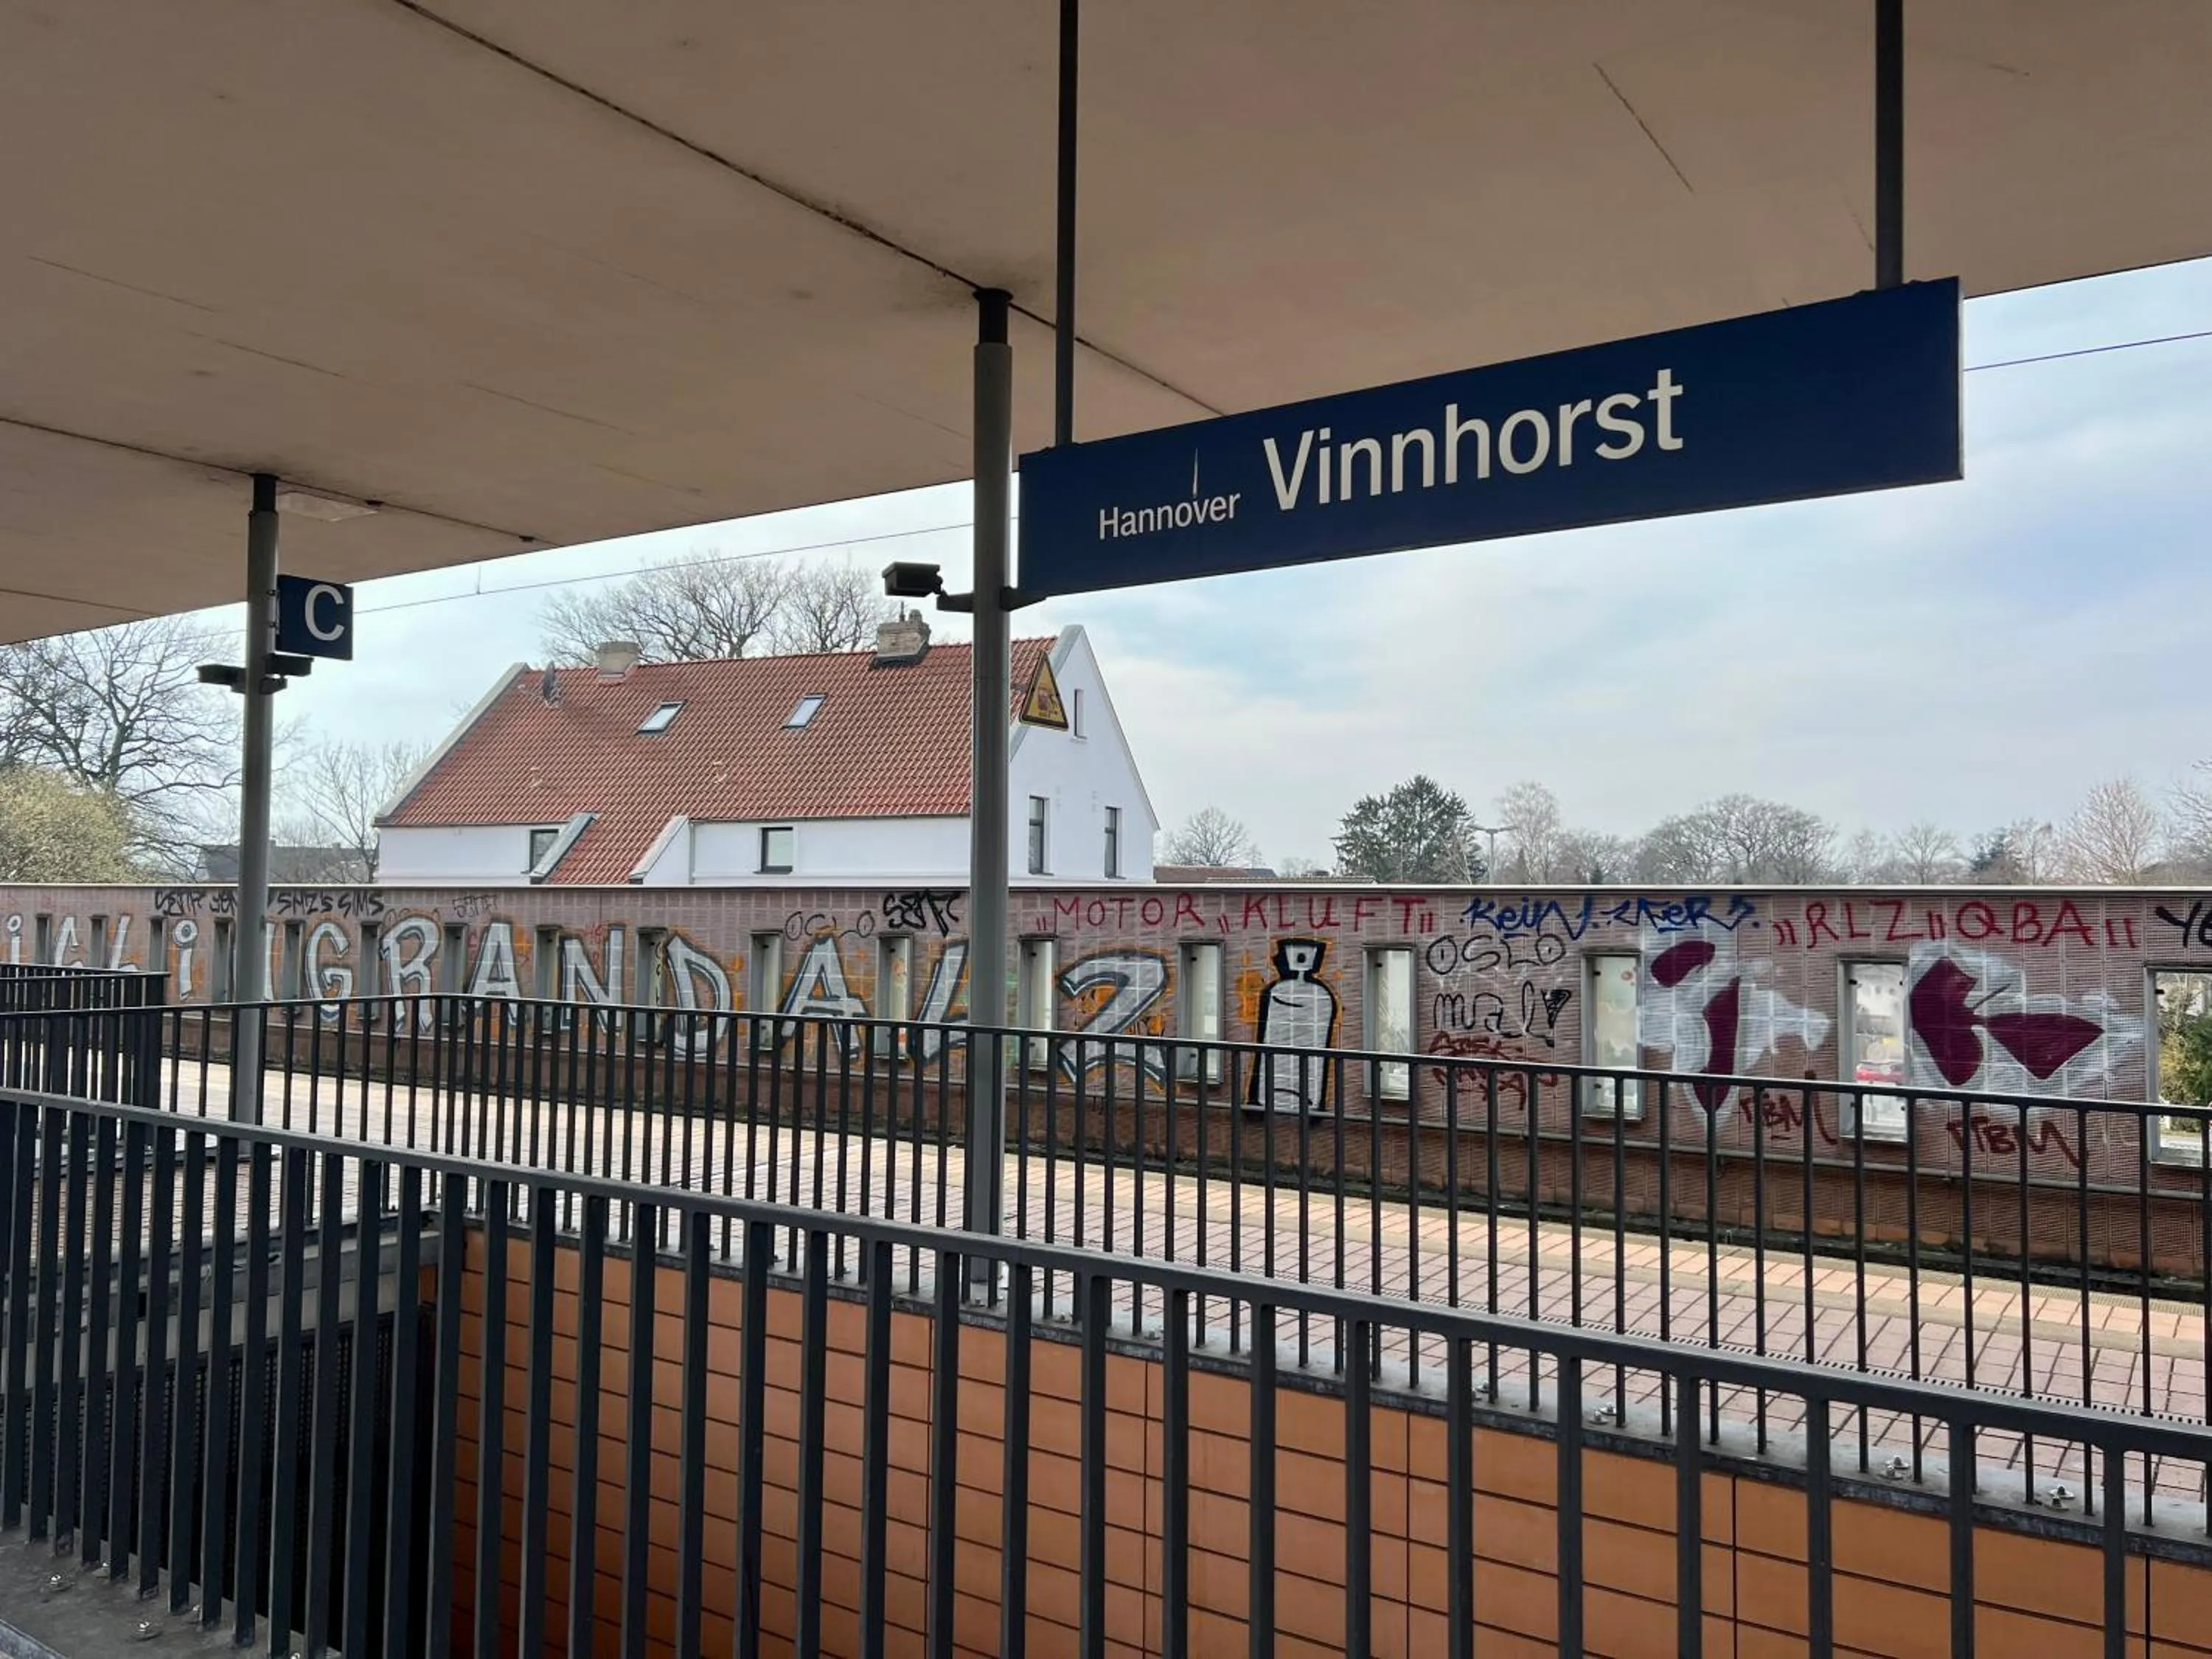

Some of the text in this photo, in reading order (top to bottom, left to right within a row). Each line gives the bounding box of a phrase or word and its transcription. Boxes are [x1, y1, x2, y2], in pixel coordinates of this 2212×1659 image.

[1099, 369, 1684, 540] Hannover Vinnhorst
[305, 584, 344, 641] C
[1427, 933, 1566, 975] OSLO
